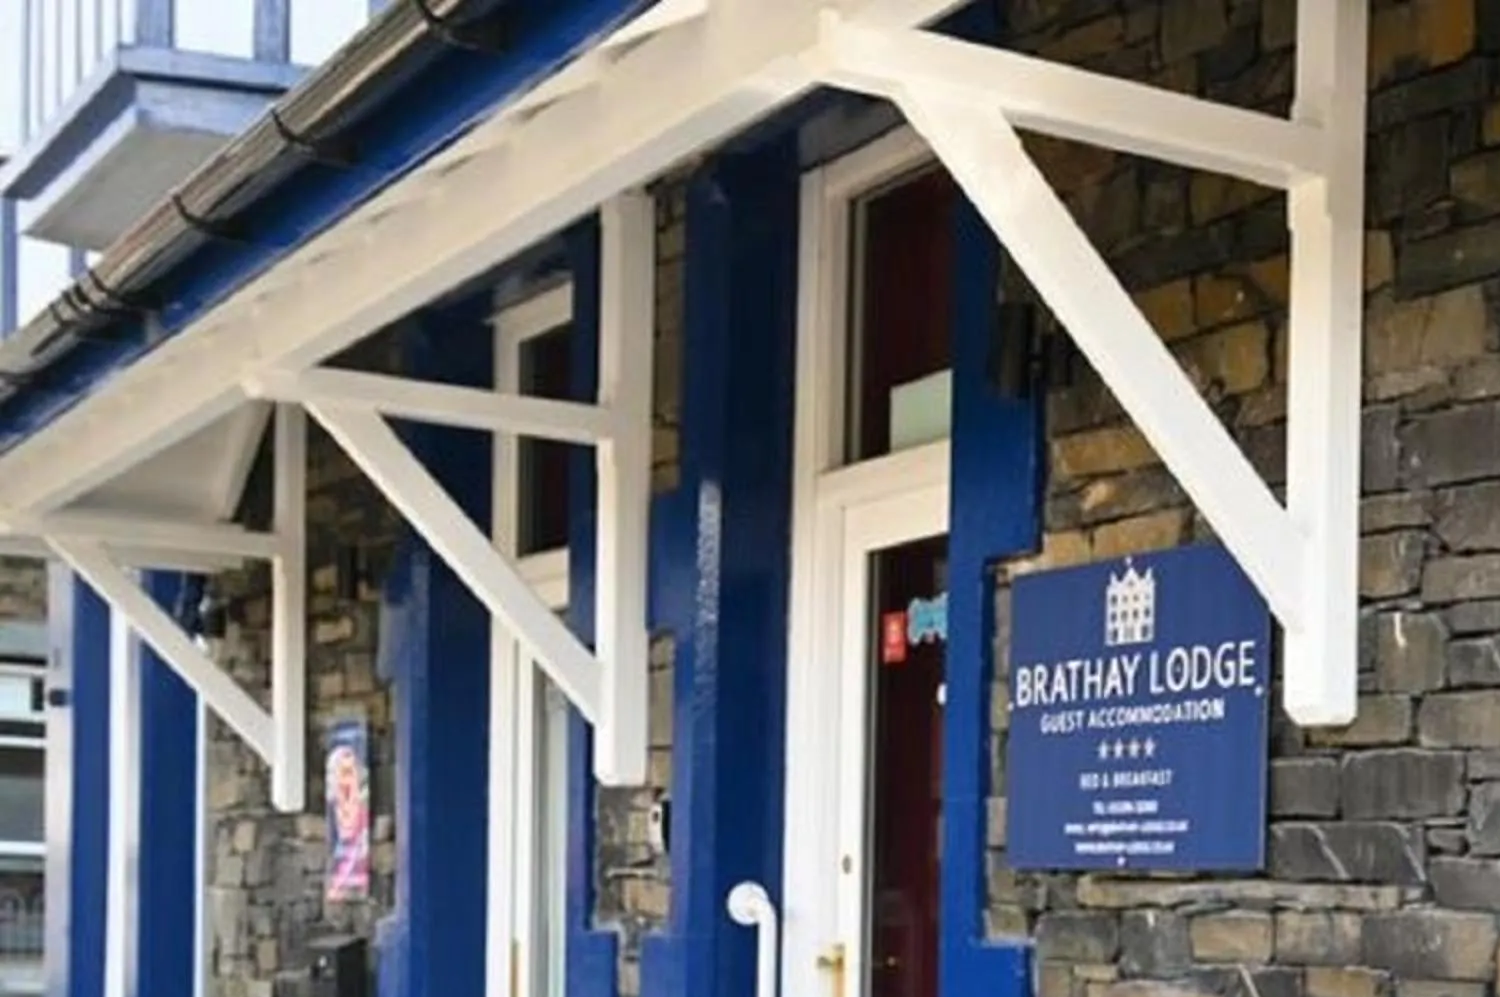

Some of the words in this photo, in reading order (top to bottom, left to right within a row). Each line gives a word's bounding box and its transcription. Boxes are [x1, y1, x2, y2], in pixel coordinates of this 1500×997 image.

[1016, 653, 1141, 707] BRATHAY
[1149, 641, 1256, 694] LODGE
[1040, 711, 1085, 733] GUEST
[1087, 698, 1225, 729] ACCOMMODATION
